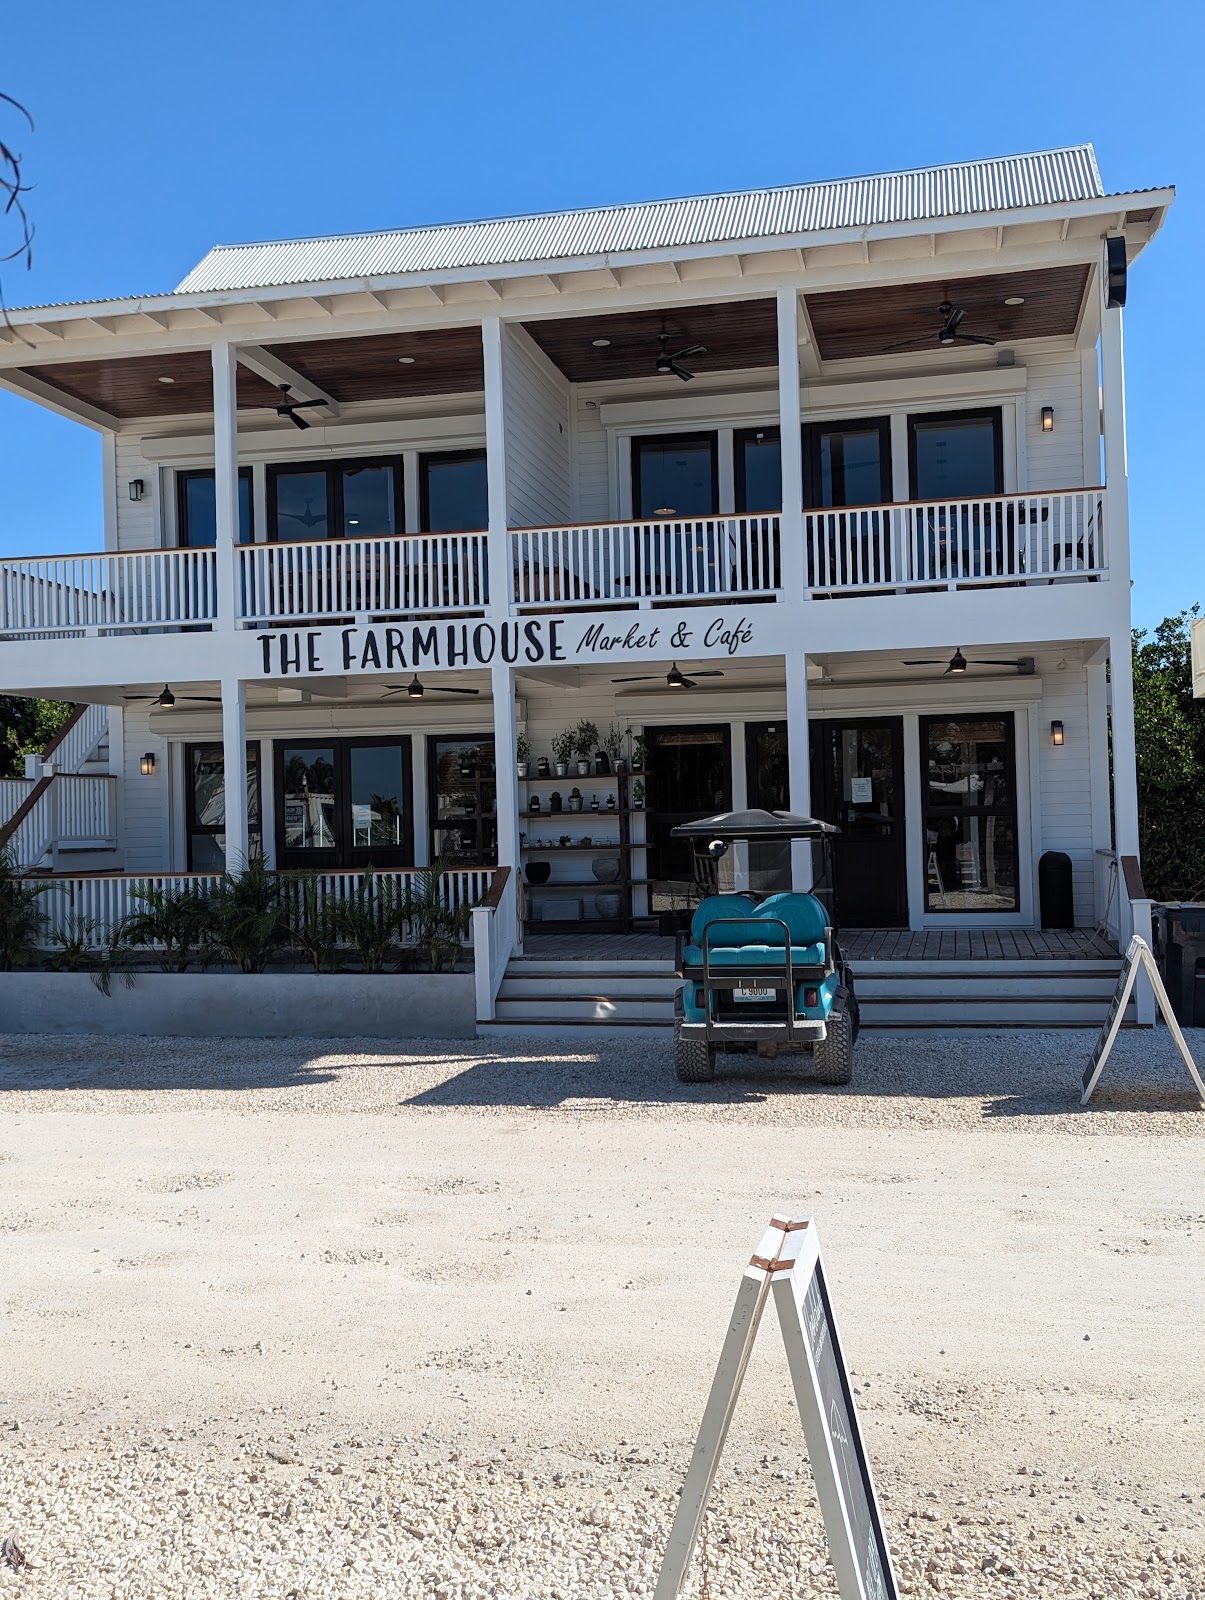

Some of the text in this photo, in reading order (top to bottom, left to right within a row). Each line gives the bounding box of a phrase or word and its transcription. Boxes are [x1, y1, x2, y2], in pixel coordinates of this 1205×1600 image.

[256, 617, 754, 675] THE FARMHOUSE Market & Café
